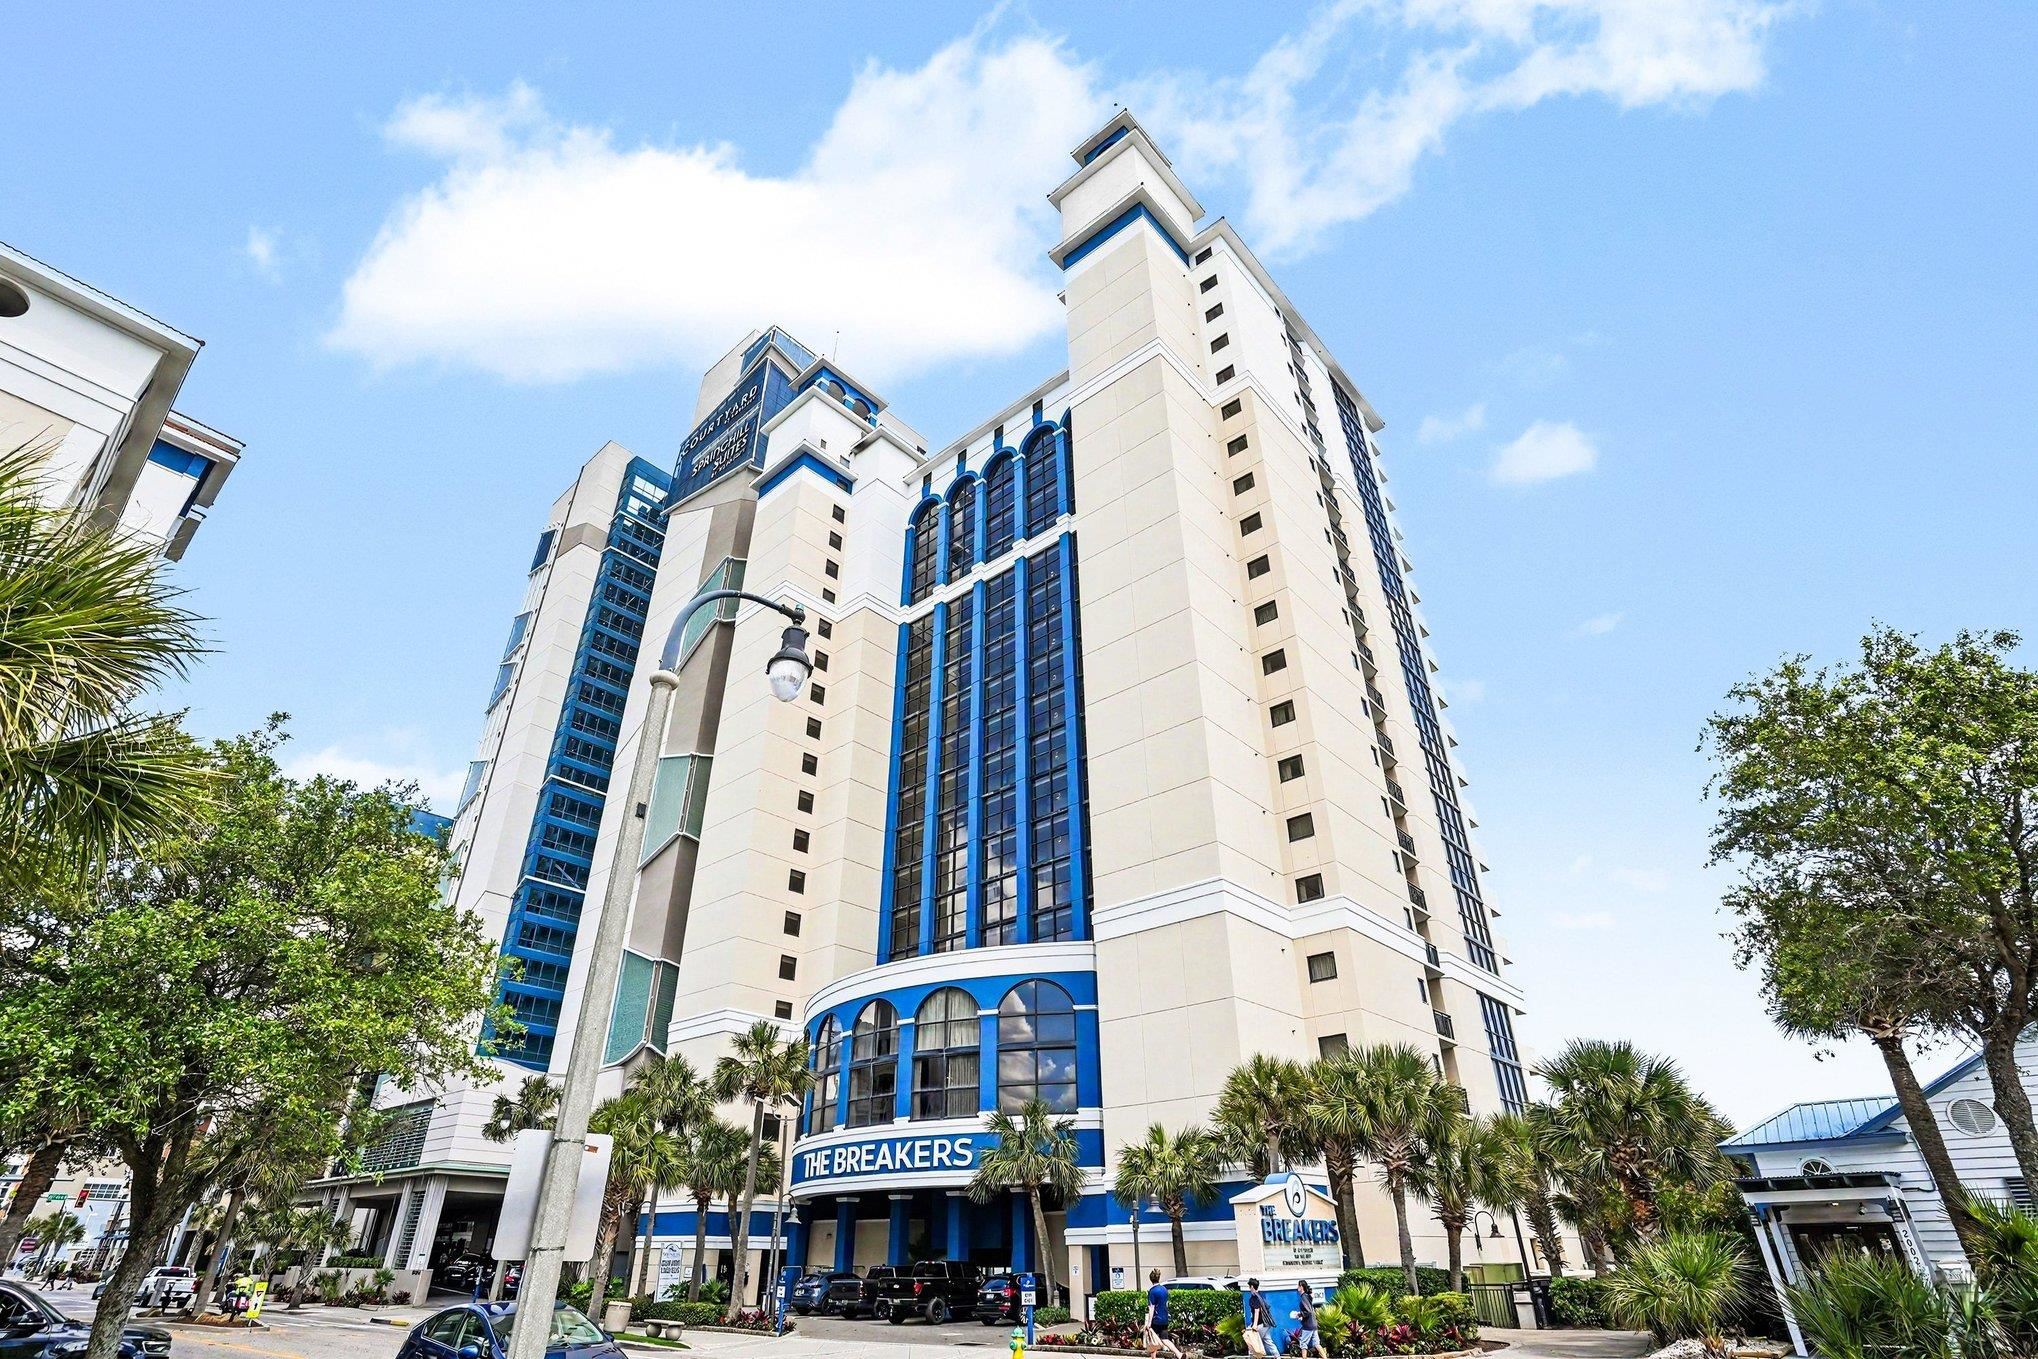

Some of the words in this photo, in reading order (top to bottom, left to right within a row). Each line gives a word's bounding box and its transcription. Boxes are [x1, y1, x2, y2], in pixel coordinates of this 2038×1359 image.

[682, 385, 758, 456] COURTYARD
[692, 422, 750, 477] SPRINGHILL
[712, 434, 749, 471] SUITES
[803, 1149, 832, 1179] THE
[833, 1137, 974, 1175] BREAKERS
[1260, 1205, 1276, 1216] THE
[1261, 1218, 1339, 1244] BREAKERS
[1901, 1229, 1921, 1266] 2002
